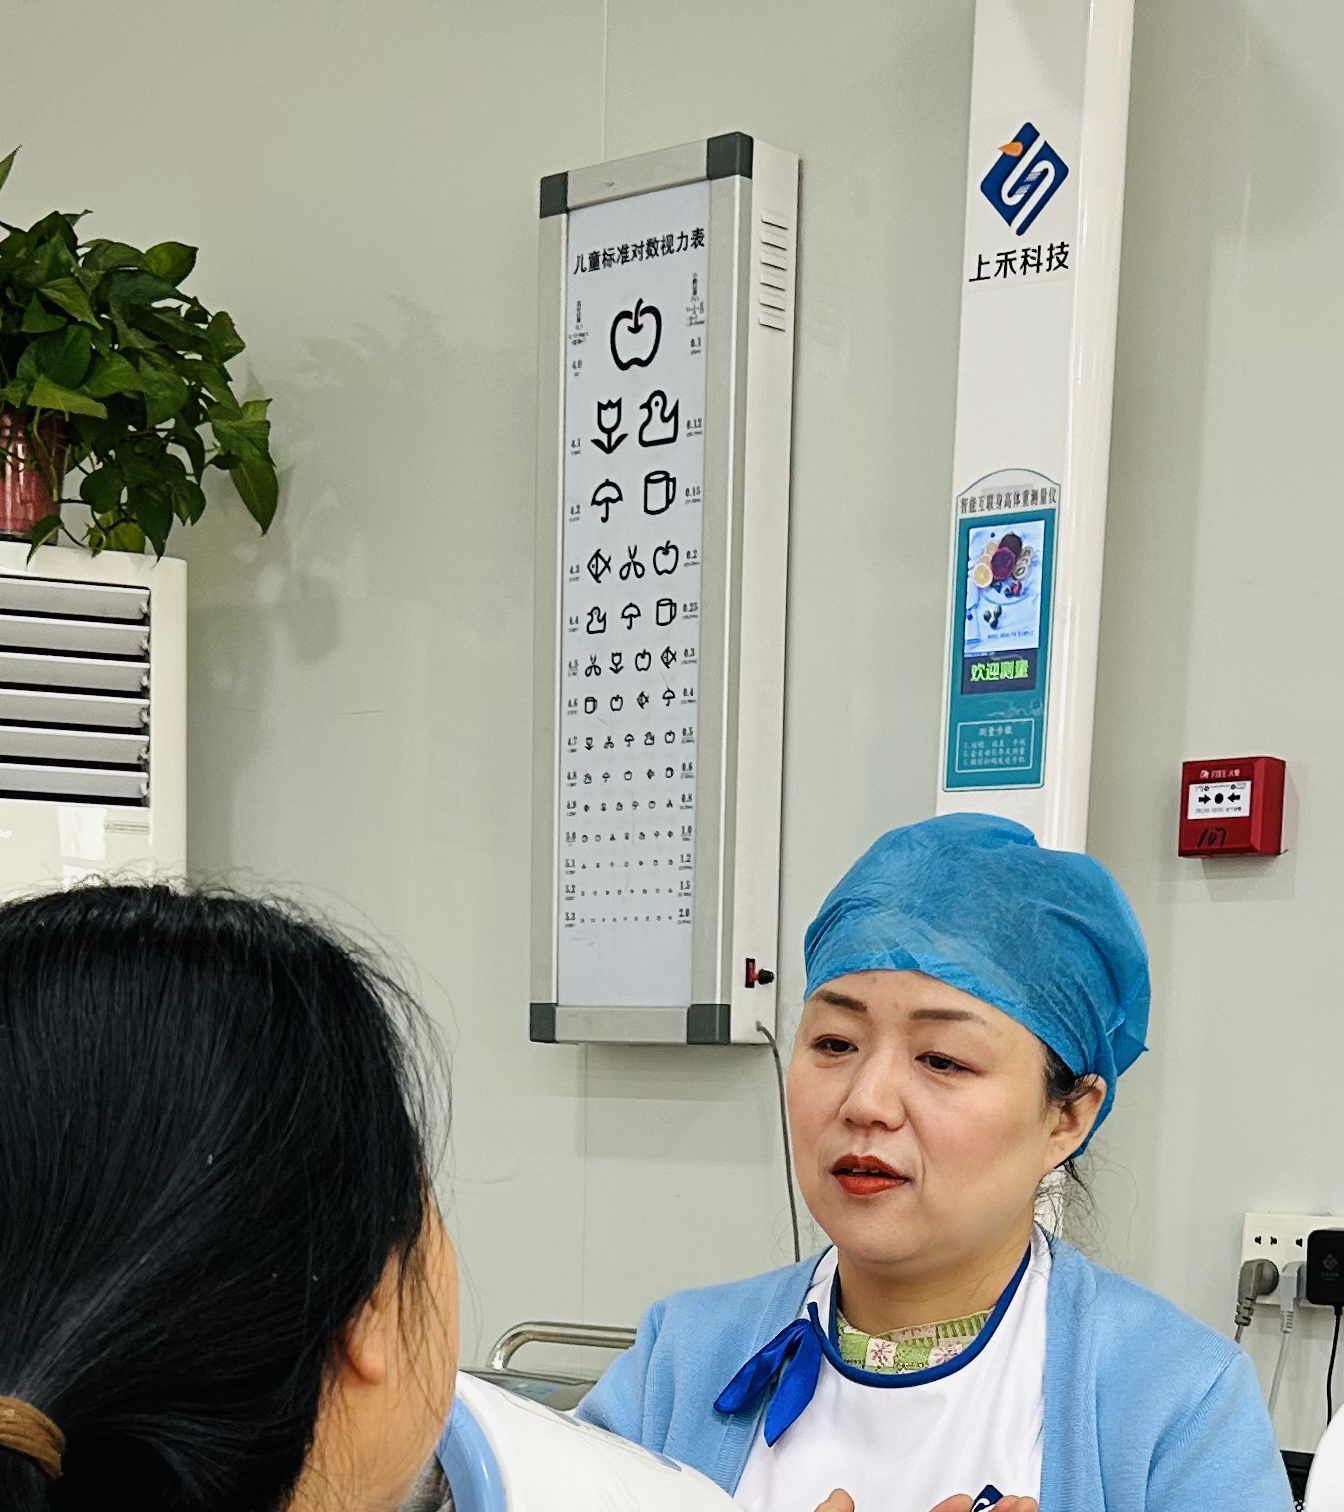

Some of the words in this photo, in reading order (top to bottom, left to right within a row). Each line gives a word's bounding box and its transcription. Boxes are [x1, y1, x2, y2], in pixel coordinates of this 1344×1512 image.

[573, 227, 705, 275] 儿童标准对数视力表
[968, 241, 1070, 283] 上禾科技
[969, 660, 1029, 682] 欢迎测量
